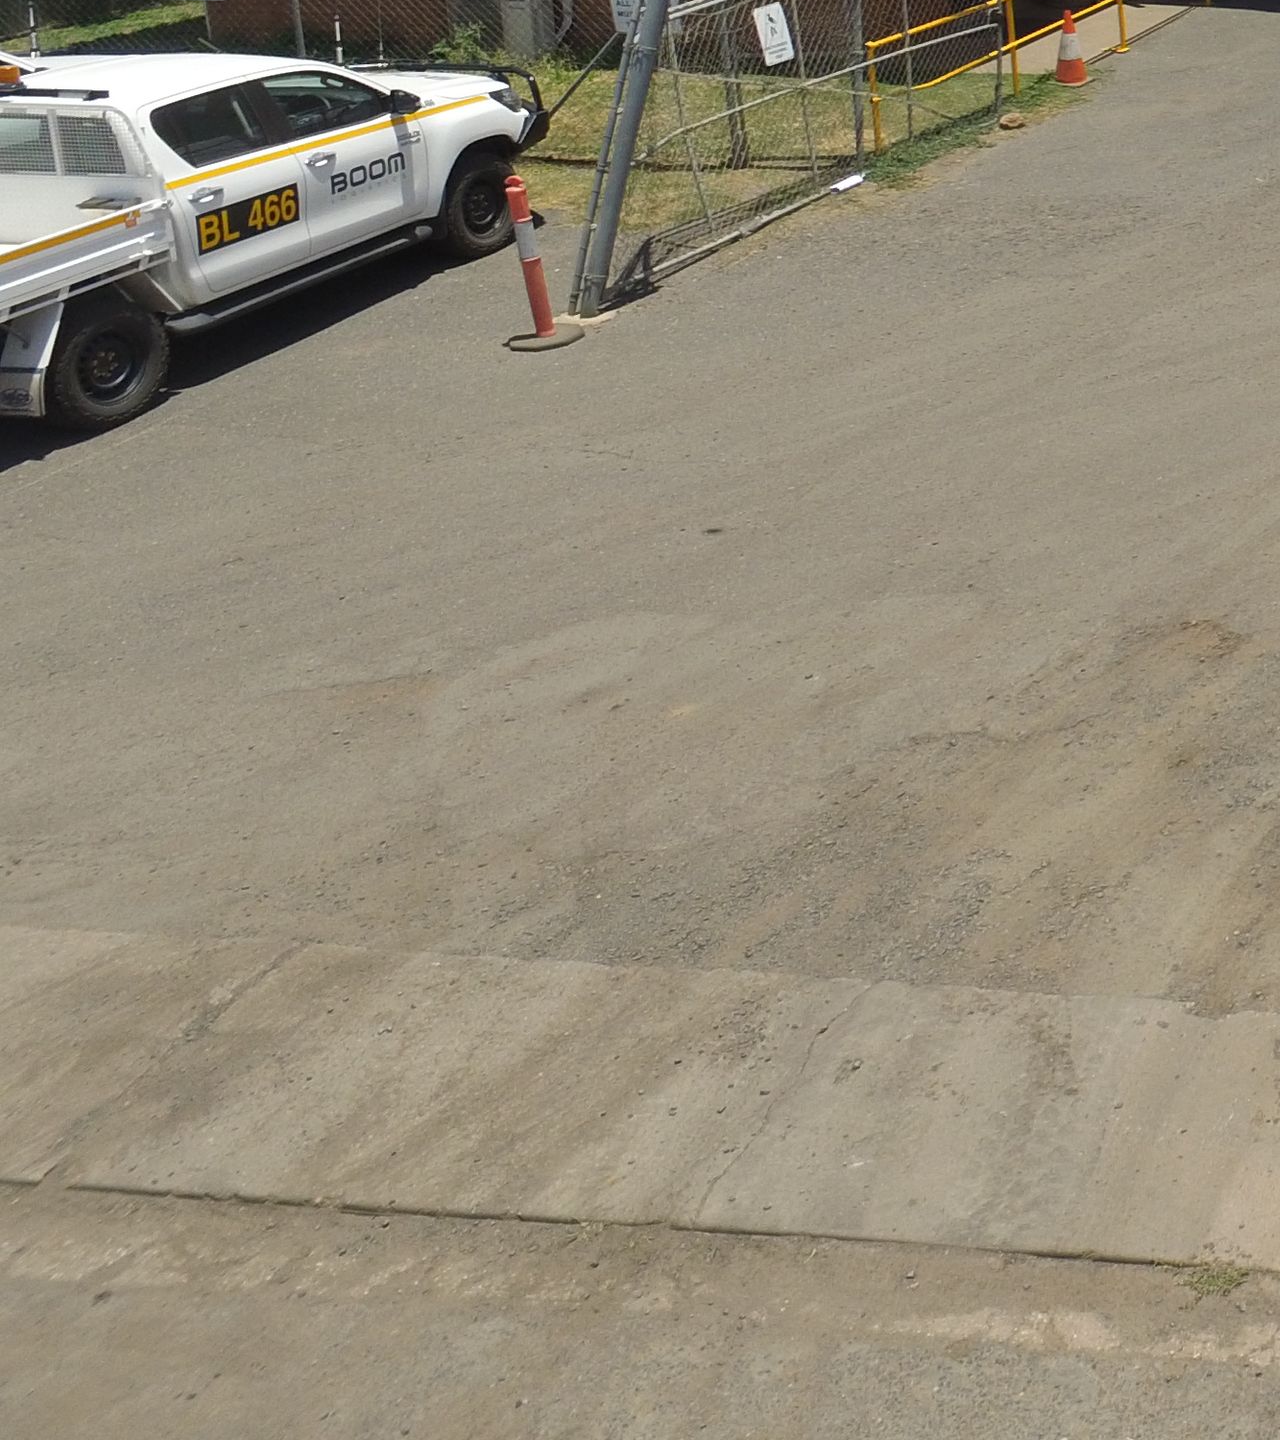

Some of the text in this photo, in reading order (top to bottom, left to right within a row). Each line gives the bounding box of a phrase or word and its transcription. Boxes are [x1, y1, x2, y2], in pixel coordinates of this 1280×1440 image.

[331, 151, 406, 195] BOOM
[199, 188, 297, 251] BL 466
